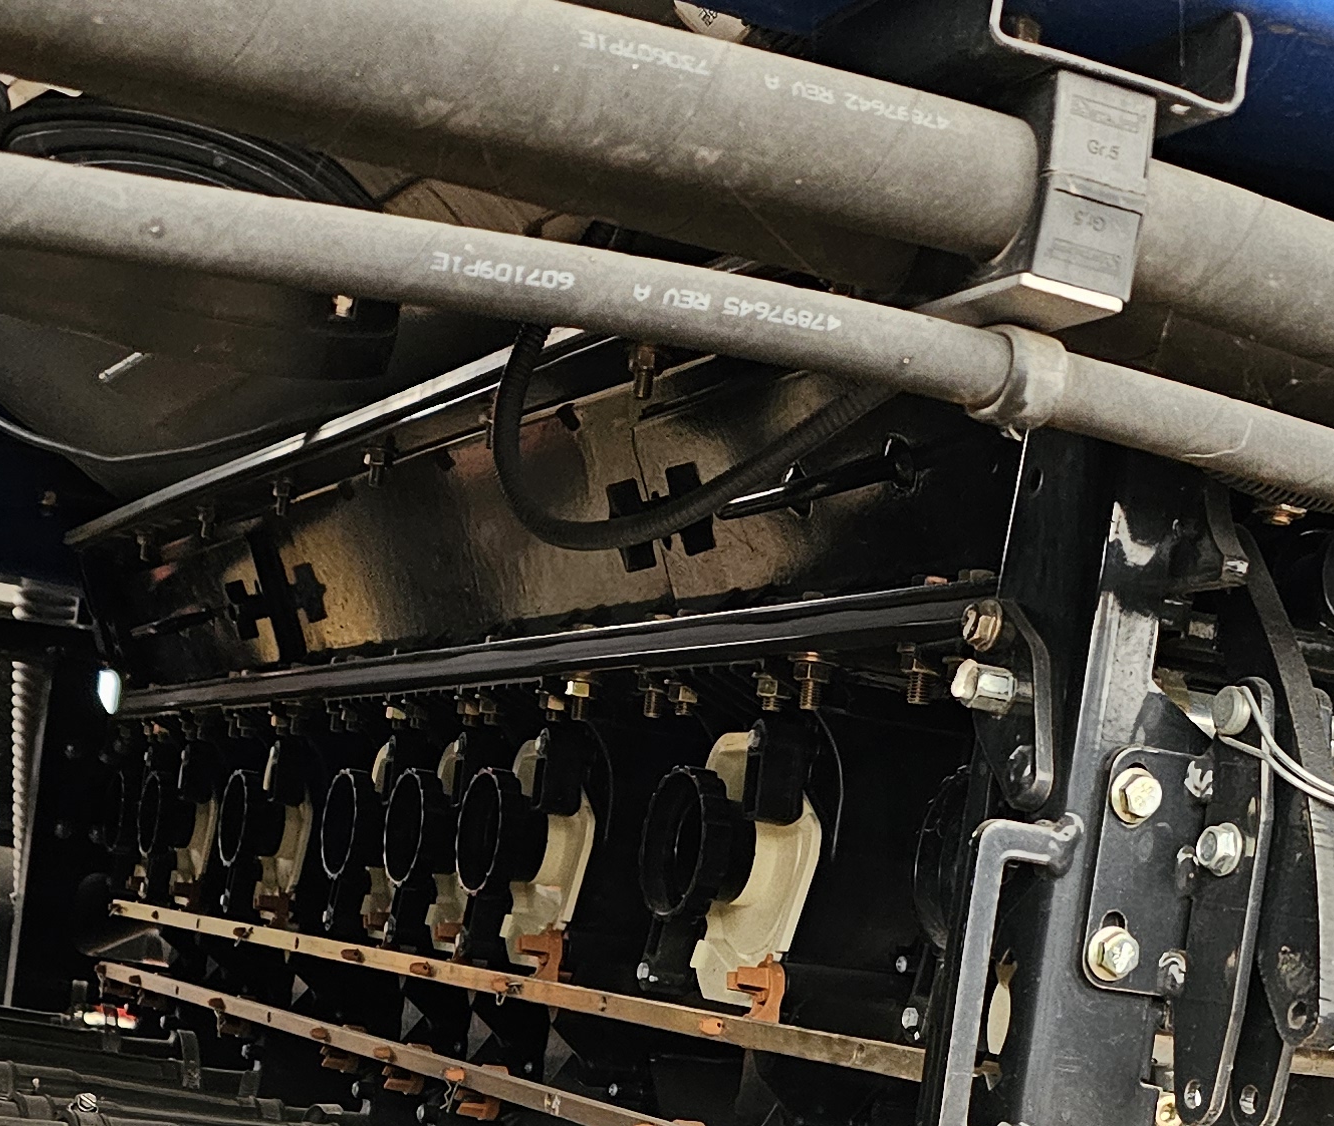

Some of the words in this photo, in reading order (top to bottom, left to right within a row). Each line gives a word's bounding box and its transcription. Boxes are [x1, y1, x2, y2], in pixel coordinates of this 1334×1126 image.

[764, 72, 780, 91] A
[791, 75, 834, 106] REV
[429, 250, 576, 291] 607109P1E
[632, 283, 651, 302] A
[662, 285, 711, 311] REV
[722, 295, 842, 332] 47897645
